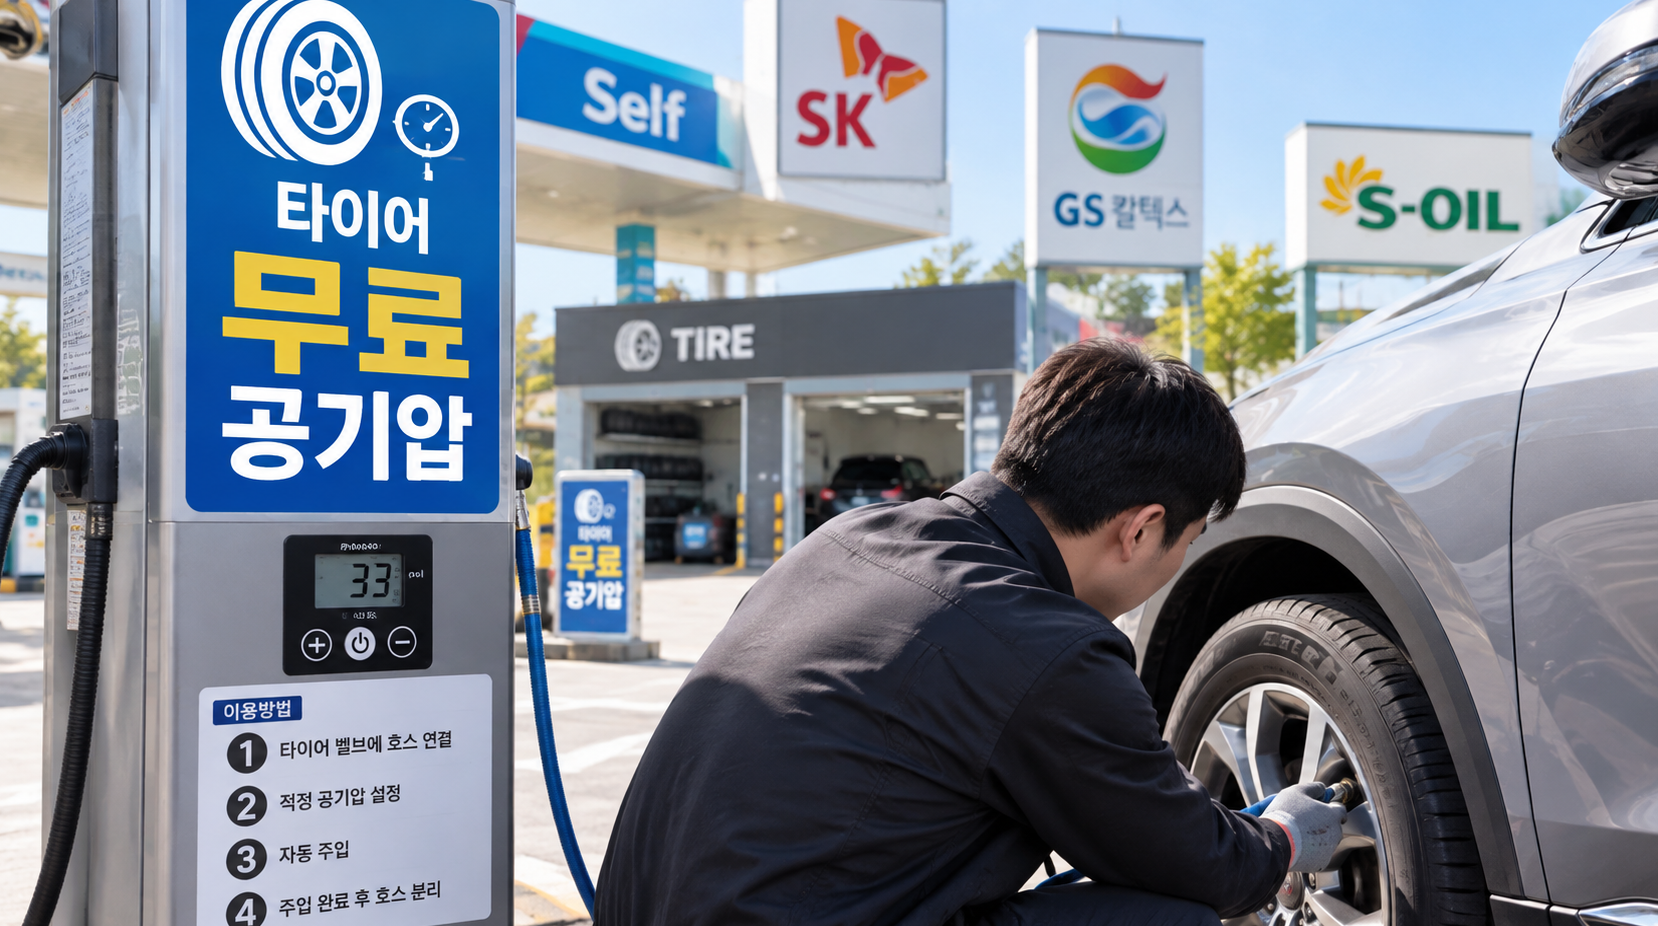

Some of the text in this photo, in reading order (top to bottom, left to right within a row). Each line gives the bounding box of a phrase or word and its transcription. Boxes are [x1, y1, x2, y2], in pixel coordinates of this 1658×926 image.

[582, 66, 687, 142] Self
[796, 90, 876, 148] SK
[277, 181, 429, 255] 타이어
[1054, 191, 1189, 231] GS 칼텍스
[1357, 185, 1520, 232] S-OIL
[222, 250, 470, 379] 무료
[671, 323, 755, 362] TIRE
[222, 385, 473, 482] 공기압
[578, 525, 612, 542] 타이어
[350, 563, 391, 598] 33
[566, 545, 622, 580] 무료
[224, 700, 292, 721] 이용방법
[239, 730, 453, 767] 1 타이어 벨브에 호스 연결
[237, 784, 401, 821] 2 적정 공기압 설정
[237, 840, 350, 874] 3 자동 주입
[235, 880, 441, 925] 4 주입 완료 후 호스 분리
